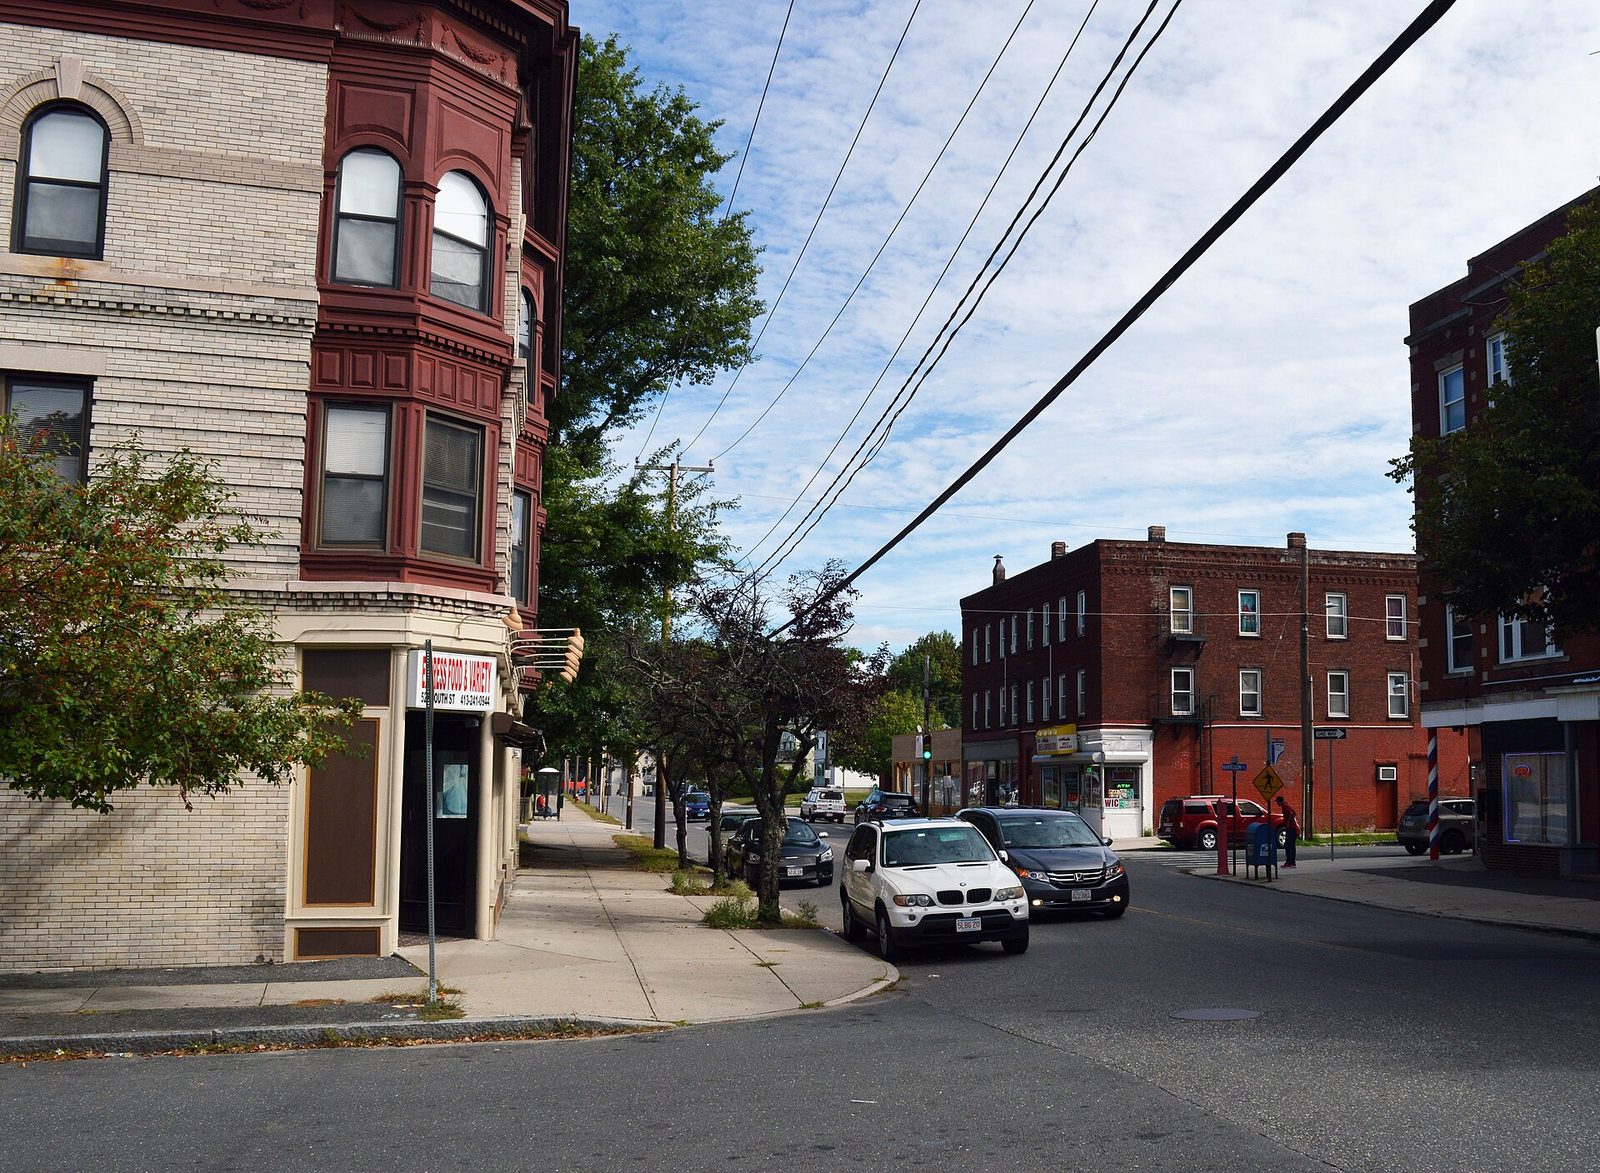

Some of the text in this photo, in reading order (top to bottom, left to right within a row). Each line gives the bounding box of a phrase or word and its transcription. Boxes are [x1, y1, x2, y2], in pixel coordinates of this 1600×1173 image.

[421, 656, 492, 693] ERESS FOOD & VARIETY
[432, 693, 448, 705] OUTH
[449, 694, 456, 705] ST
[1104, 799, 1119, 807] WIC
